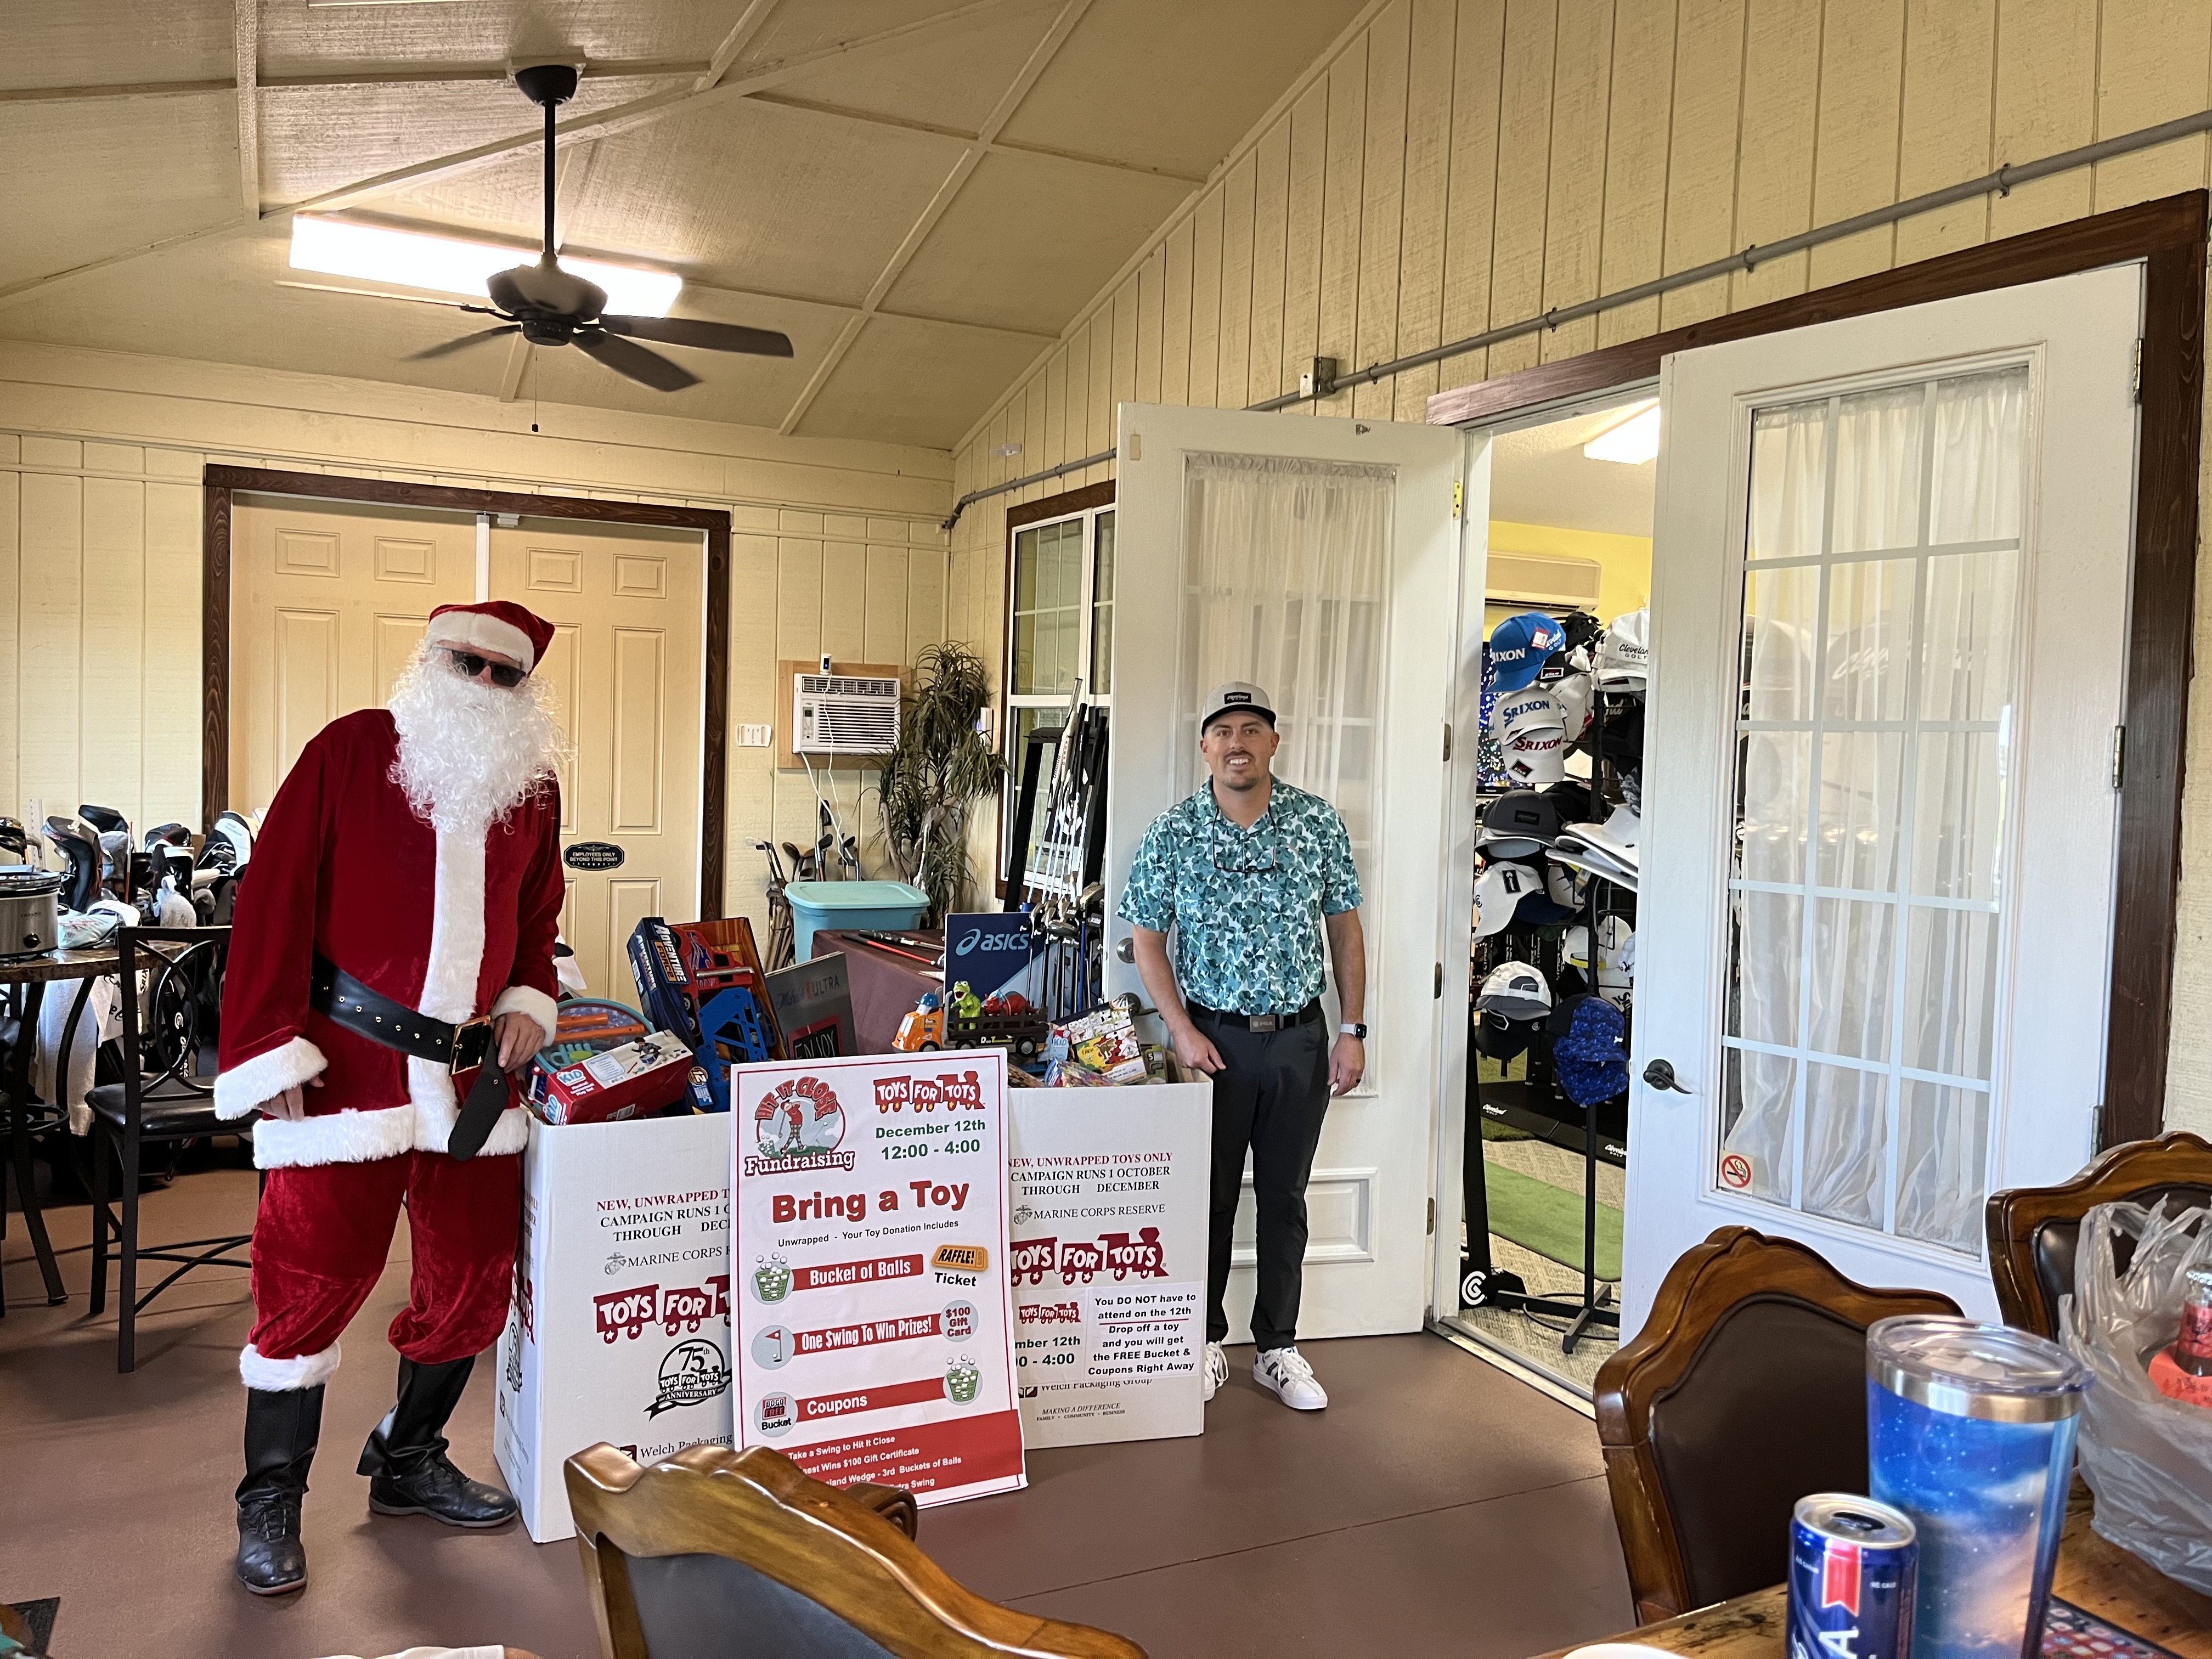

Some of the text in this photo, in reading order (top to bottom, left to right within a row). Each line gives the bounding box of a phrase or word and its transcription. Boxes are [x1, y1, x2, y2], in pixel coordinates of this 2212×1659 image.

[1503, 701, 1550, 729] SRIXON
[1513, 736, 1562, 752] SRIXON
[812, 975, 840, 996] ULTRA
[795, 1030, 835, 1059] ENJOY
[559, 1070, 584, 1082] KID
[755, 1076, 838, 1121] HIT IT CLOSE
[877, 1081, 975, 1101] TOYS FOR TOTS
[876, 1120, 985, 1138] December 12th
[882, 1144, 928, 1160] 12:00
[944, 1139, 980, 1154] 4:00
[745, 1151, 855, 1174] Fundraising
[1037, 1155, 1109, 1167] UNWRAPPED
[1112, 1154, 1141, 1164] TOYS
[1144, 1152, 1172, 1162] ONLY
[1011, 1166, 1170, 1182] CAMPAIGN RUNS 1 OCTOBER
[1022, 1181, 1159, 1195] THROUGH DECEMBER
[597, 1199, 630, 1211] NEW,
[635, 1190, 718, 1207] UNWRAPPED
[773, 1181, 969, 1223] Bring a Toy
[600, 1210, 673, 1228] CAMPAIGN
[677, 1207, 710, 1219] RUNS
[715, 1206, 719, 1215] 1
[1034, 1204, 1165, 1219] MARINE CORPS RESERVE
[613, 1226, 681, 1242] THROUGH
[778, 1234, 829, 1247] Unwrapped
[842, 1231, 862, 1240] Your
[865, 1228, 881, 1238] Toy
[883, 1224, 921, 1235] Donation
[924, 1220, 958, 1231] Includes
[628, 1252, 679, 1267] MARINE
[682, 1246, 722, 1260] CORPS
[938, 1249, 975, 1264] RAFFLE!
[1063, 1248, 1098, 1269] FOR
[1110, 1245, 1156, 1267] TOTS
[810, 1260, 911, 1286] Bucket of Balls
[934, 1272, 977, 1286] Ticket
[1135, 1295, 1157, 1304] NOT
[600, 1295, 653, 1324] TOYS
[665, 1295, 706, 1316] FOR
[946, 1306, 970, 1319] $100
[1021, 1307, 1076, 1318] TOYS FOR TOTS
[1098, 1310, 1131, 1319] attend
[1170, 1307, 1191, 1315] 12th
[949, 1317, 968, 1327] Gift
[1109, 1325, 1133, 1334] Drop
[1136, 1324, 1150, 1332] off
[1164, 1323, 1179, 1331] toy
[802, 1333, 823, 1351] One
[861, 1325, 873, 1342] To
[876, 1320, 895, 1340] Win
[898, 1316, 932, 1338] Prizes!
[947, 1327, 972, 1338] Card
[1015, 1336, 1080, 1348] mber 12th
[1102, 1335, 1184, 1348] and you will get
[1042, 1353, 1075, 1365] 4:00
[1093, 1353, 1110, 1361] the
[1113, 1351, 1141, 1360] FREE
[1144, 1349, 1180, 1358] Bucket
[1088, 1363, 1194, 1376] Coupons Right Away
[661, 1377, 678, 1387] TOYS
[701, 1373, 718, 1381] TOTS
[665, 1389, 716, 1400] ANNIVERSARY
[765, 1407, 784, 1417] FREE
[807, 1396, 867, 1415] Coupons
[1042, 1407, 1070, 1415] MAKING
[1077, 1403, 1121, 1412] DIFFERENCE
[761, 1418, 792, 1430] Bucket
[641, 1443, 674, 1458] Welch
[788, 1451, 807, 1460] Take
[816, 1445, 840, 1455] Swing
[853, 1440, 864, 1449] Hit
[873, 1436, 895, 1446] Close
[822, 1448, 919, 1472] Wins $100 Gift Certificate
[849, 1472, 876, 1483] Wedge
[882, 1468, 895, 1476] 3rd
[900, 1461, 930, 1474] Buckets
[933, 1459, 940, 1468] of
[943, 1456, 962, 1466] Balls
[911, 1477, 935, 1488] Swing
